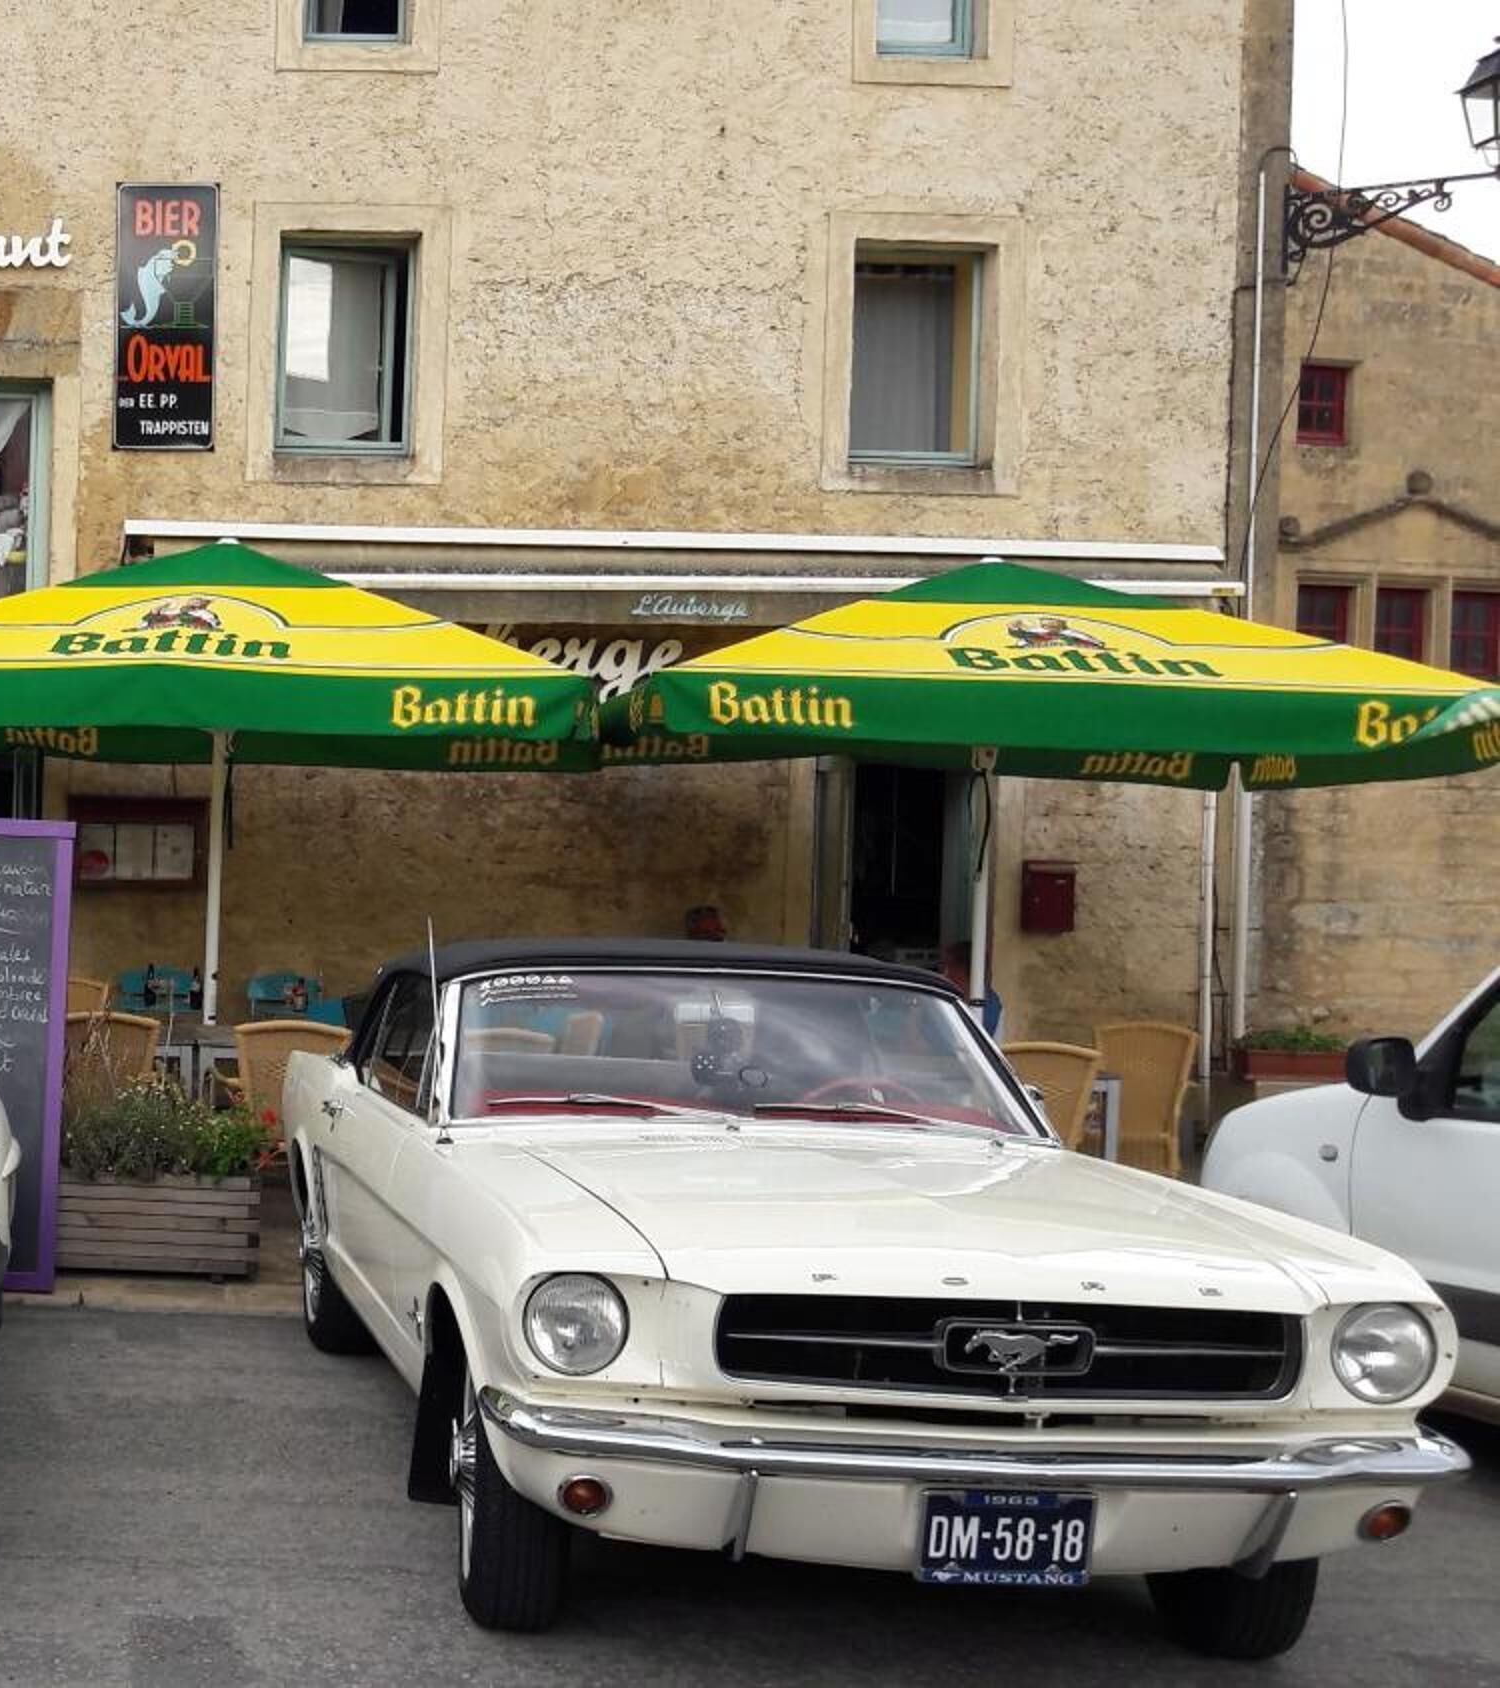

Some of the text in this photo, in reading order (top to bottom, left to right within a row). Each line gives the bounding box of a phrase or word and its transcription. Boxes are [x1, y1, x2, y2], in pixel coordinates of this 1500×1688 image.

[135, 200, 200, 236] BIER
[127, 334, 210, 383] ORVAL
[140, 420, 209, 436] TRAPPISTEN
[50, 629, 291, 658] Battin
[946, 647, 1224, 677] Battin
[391, 685, 536, 729] Battin
[708, 681, 854, 729] Battin
[928, 1515, 1085, 1563] DM-58-18
[963, 1571, 1074, 1584] MUSTANG
